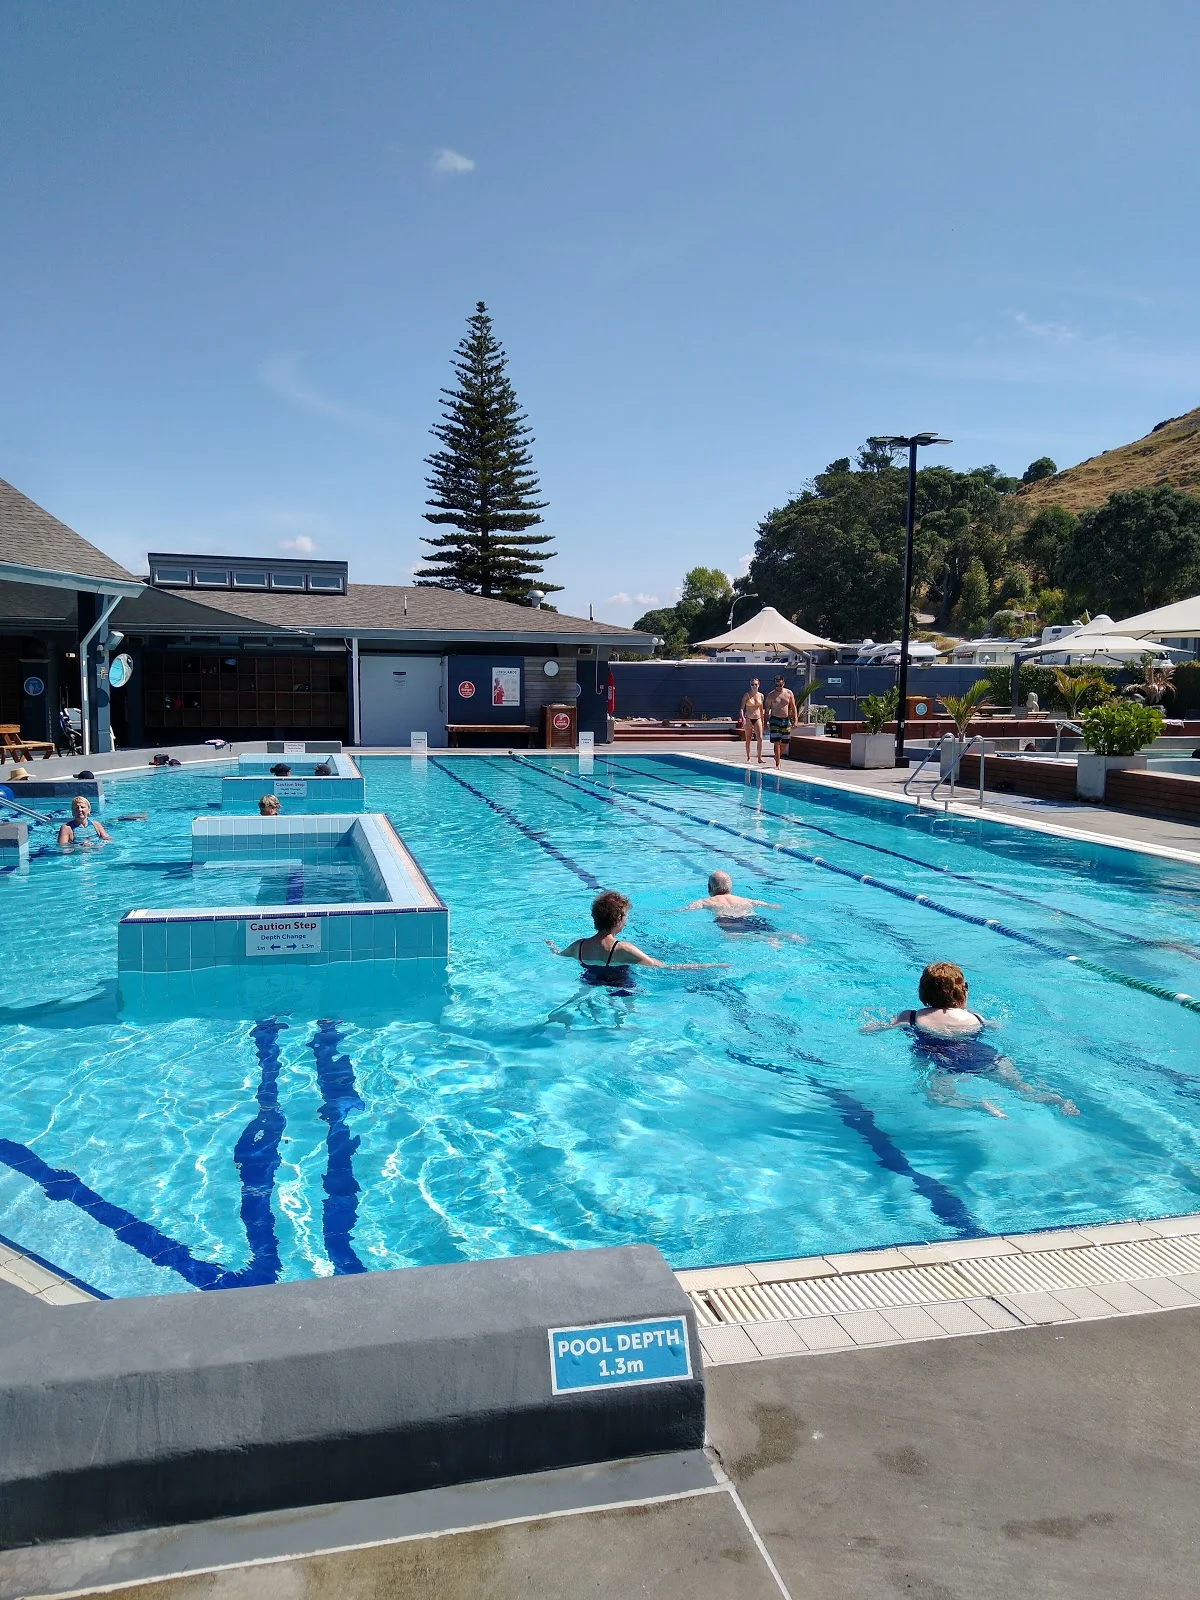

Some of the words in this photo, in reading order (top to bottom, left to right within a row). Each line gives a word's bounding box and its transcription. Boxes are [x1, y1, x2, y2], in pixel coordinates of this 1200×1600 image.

[250, 923, 291, 931] Caution
[293, 921, 317, 930] Step
[557, 1337, 613, 1358] POOL
[617, 1328, 680, 1352] DEPTH
[599, 1357, 644, 1377] 1.3m
